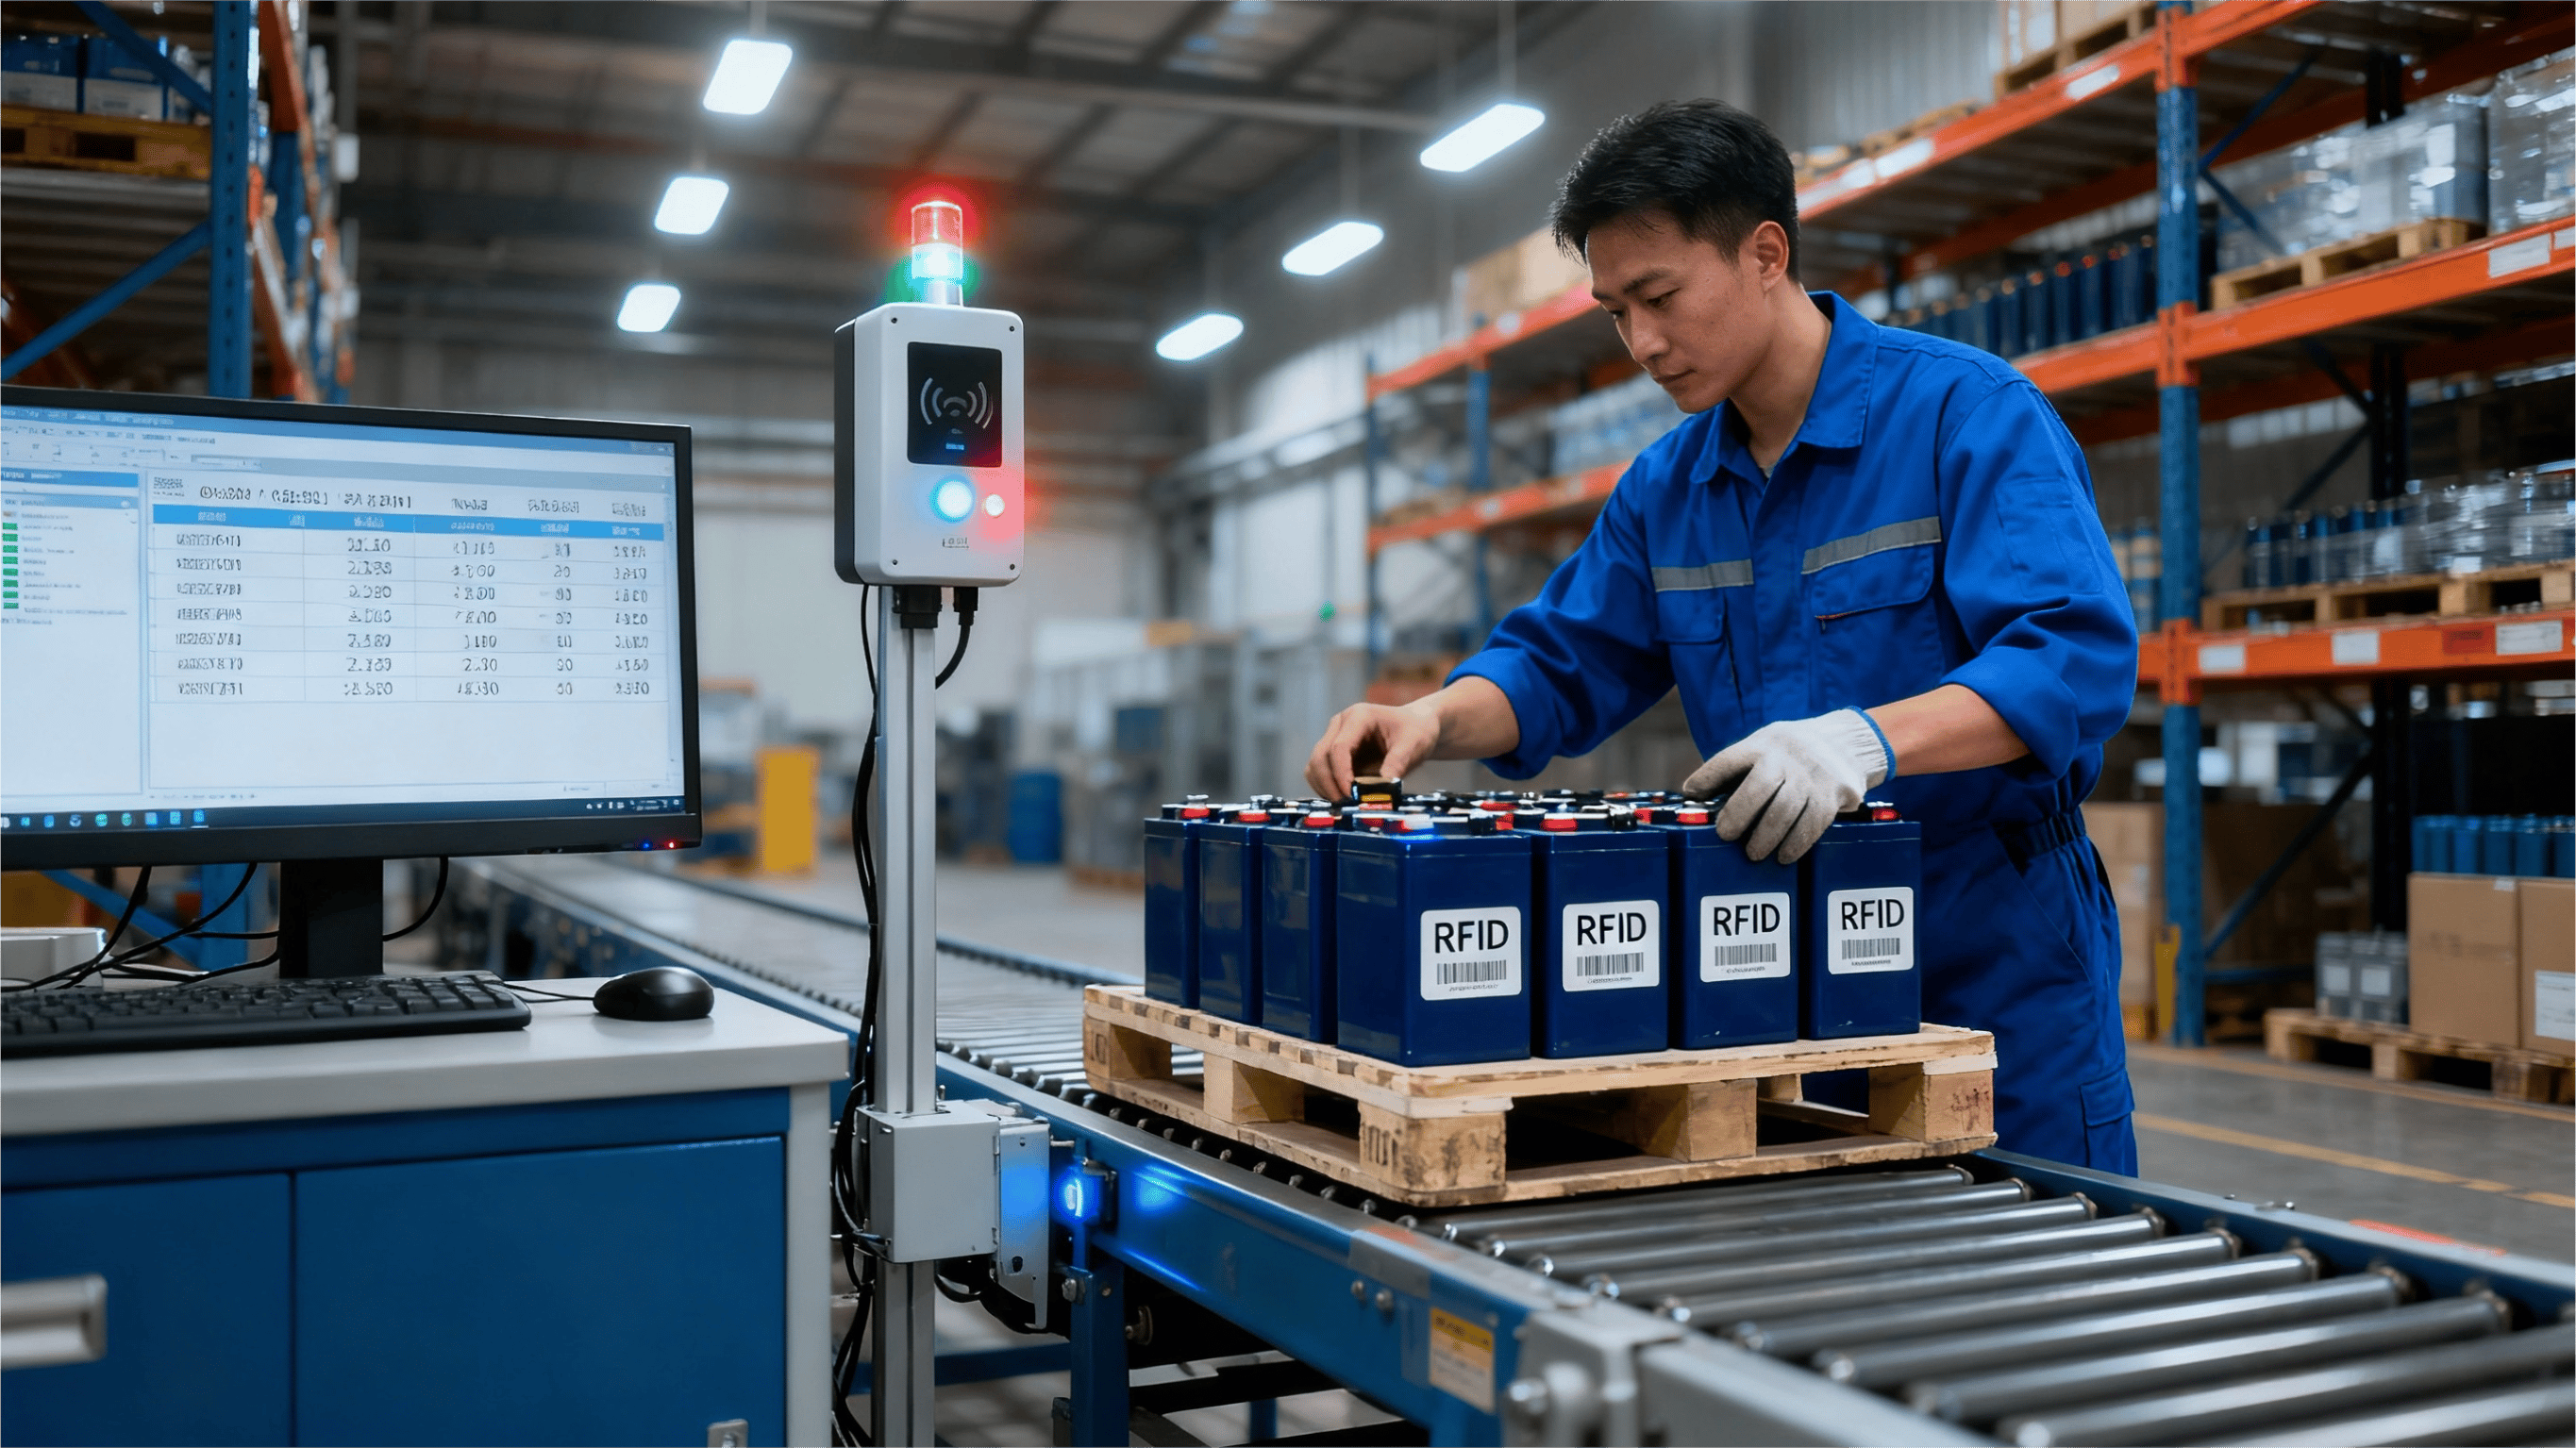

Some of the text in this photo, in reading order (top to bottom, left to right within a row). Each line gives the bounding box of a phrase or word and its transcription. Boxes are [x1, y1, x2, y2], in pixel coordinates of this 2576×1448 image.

[1577, 912, 1647, 946] RFID
[1714, 903, 1781, 937] RFID
[1841, 898, 1905, 931] RFID
[1434, 919, 1509, 954] RFID
